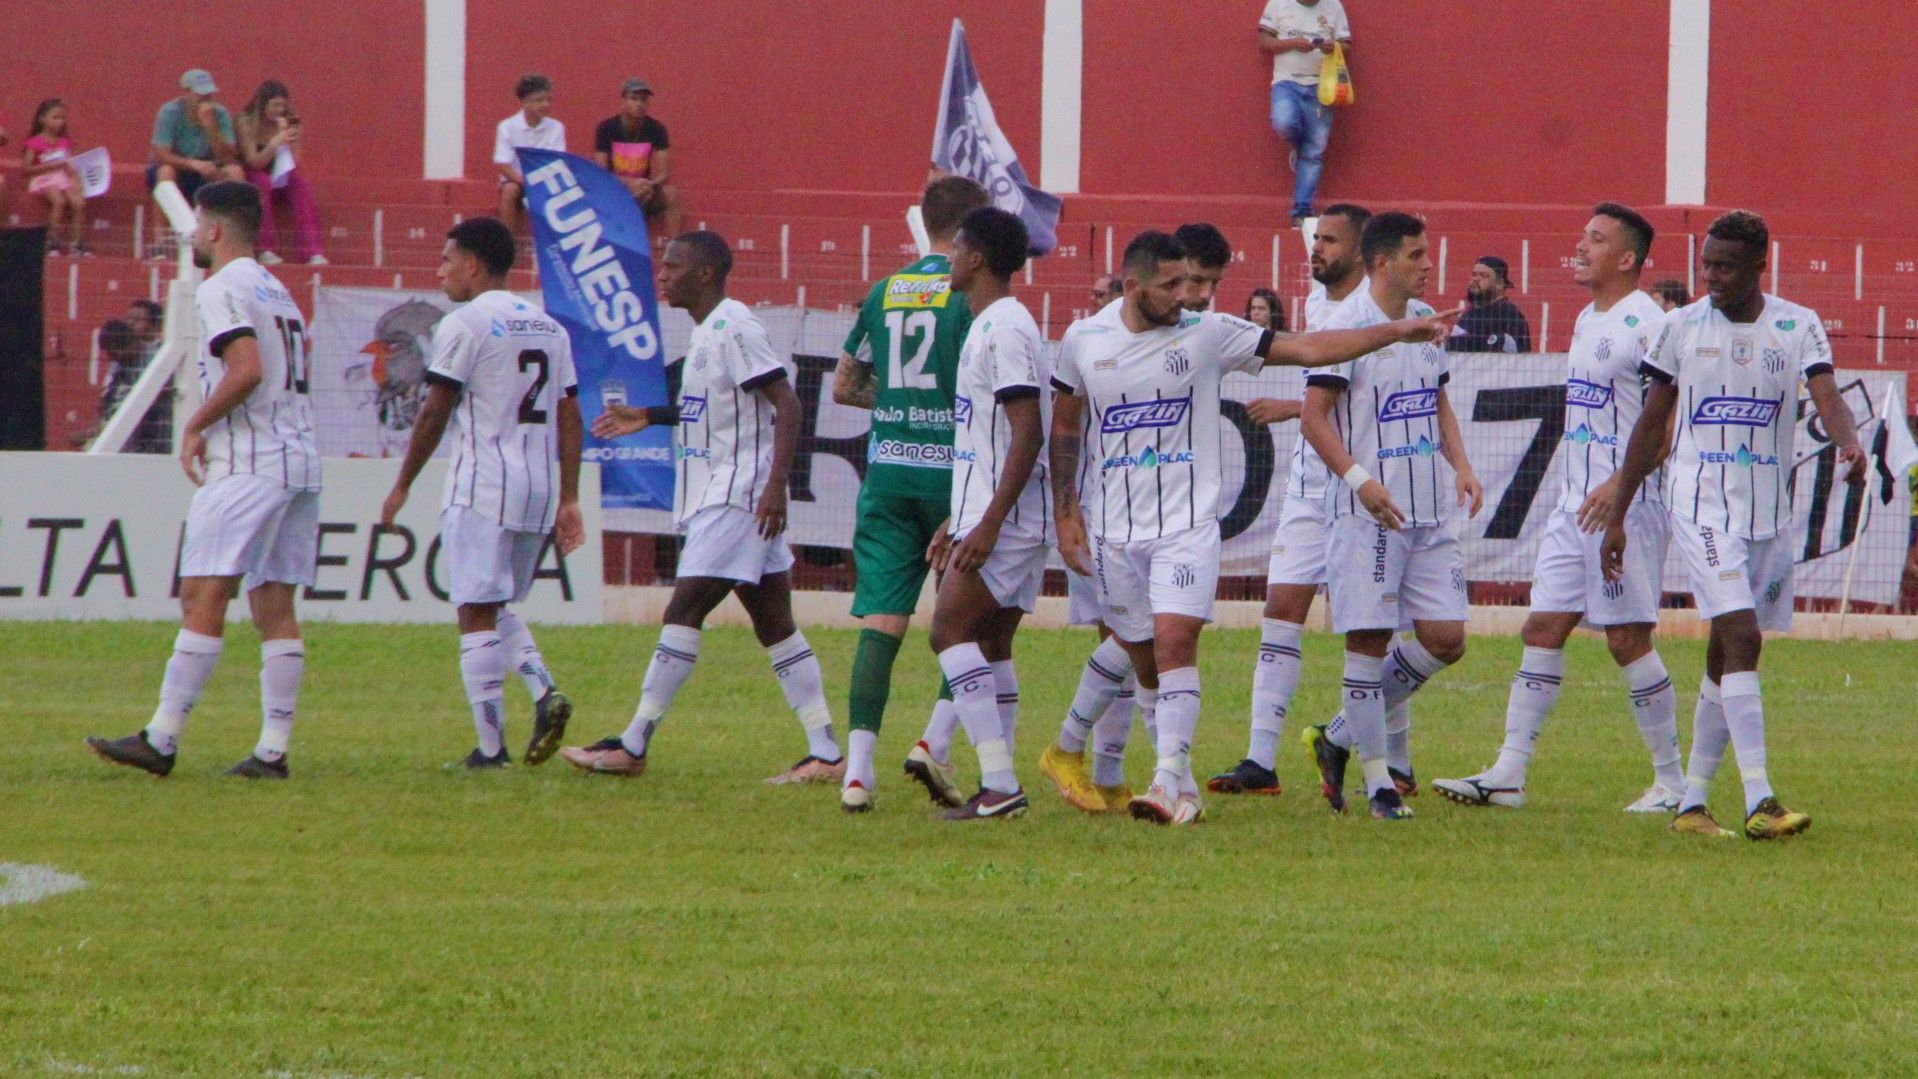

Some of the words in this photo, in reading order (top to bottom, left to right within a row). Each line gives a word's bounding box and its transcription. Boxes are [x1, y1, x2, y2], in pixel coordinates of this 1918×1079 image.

[526, 159, 658, 361] FUNESP
[1060, 245, 1077, 257] 22
[274, 315, 309, 394] 10
[885, 311, 938, 390] 12
[518, 349, 549, 424] 2
[1105, 402, 1186, 427] GAZIN
[1701, 402, 1777, 421] GAZIN
[1158, 452, 1195, 465] PLAC
[1376, 445, 1421, 461] GREEN
[1472, 384, 1567, 539] 7
[0, 518, 136, 598] TA
[1372, 522, 1389, 584] standard
